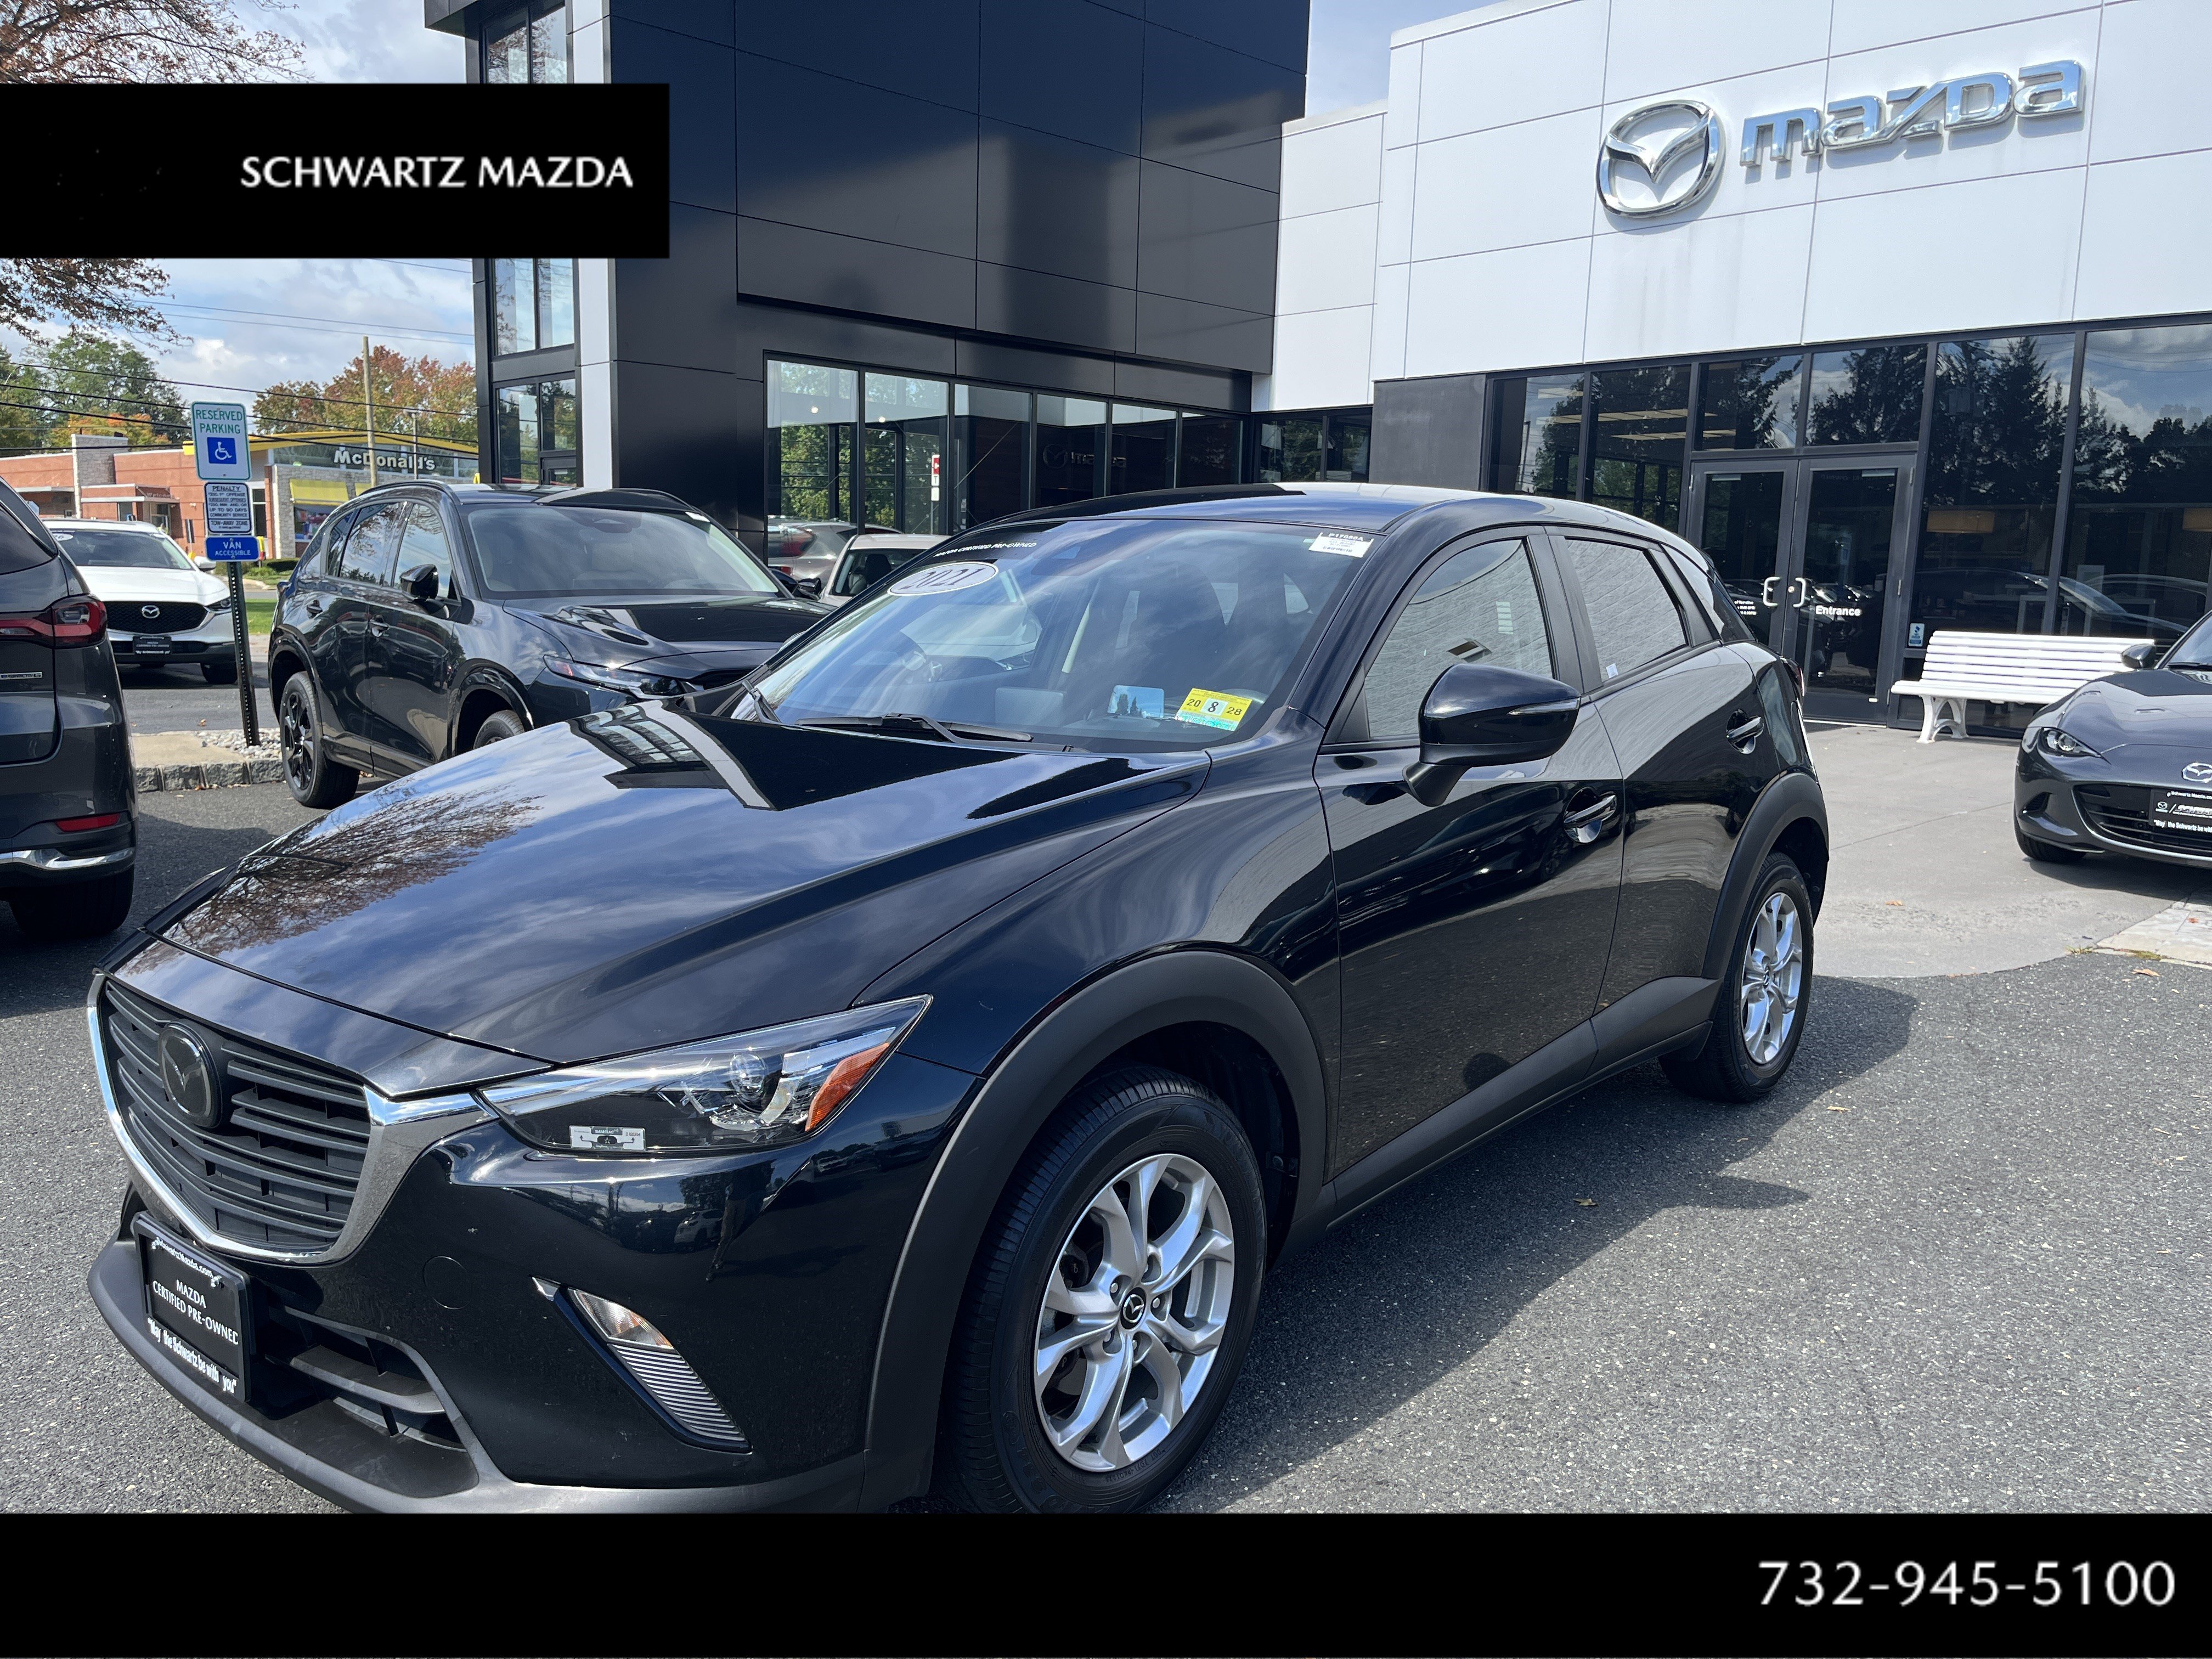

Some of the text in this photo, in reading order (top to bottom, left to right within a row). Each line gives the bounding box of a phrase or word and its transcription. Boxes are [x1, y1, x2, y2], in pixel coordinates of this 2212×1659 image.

[195, 409, 242, 421] RESERVED
[200, 423, 240, 434] PARKING
[898, 567, 986, 590] 2021
[1815, 605, 1861, 616] Entrance
[1187, 698, 1242, 716] 20 8 28
[153, 1280, 186, 1313] CERTIFIED
[176, 1279, 206, 1308] MAZDA
[163, 1330, 172, 1348] the
[173, 1336, 198, 1368] Schwartz
[198, 1354, 206, 1373] be
[206, 1363, 219, 1383] with
